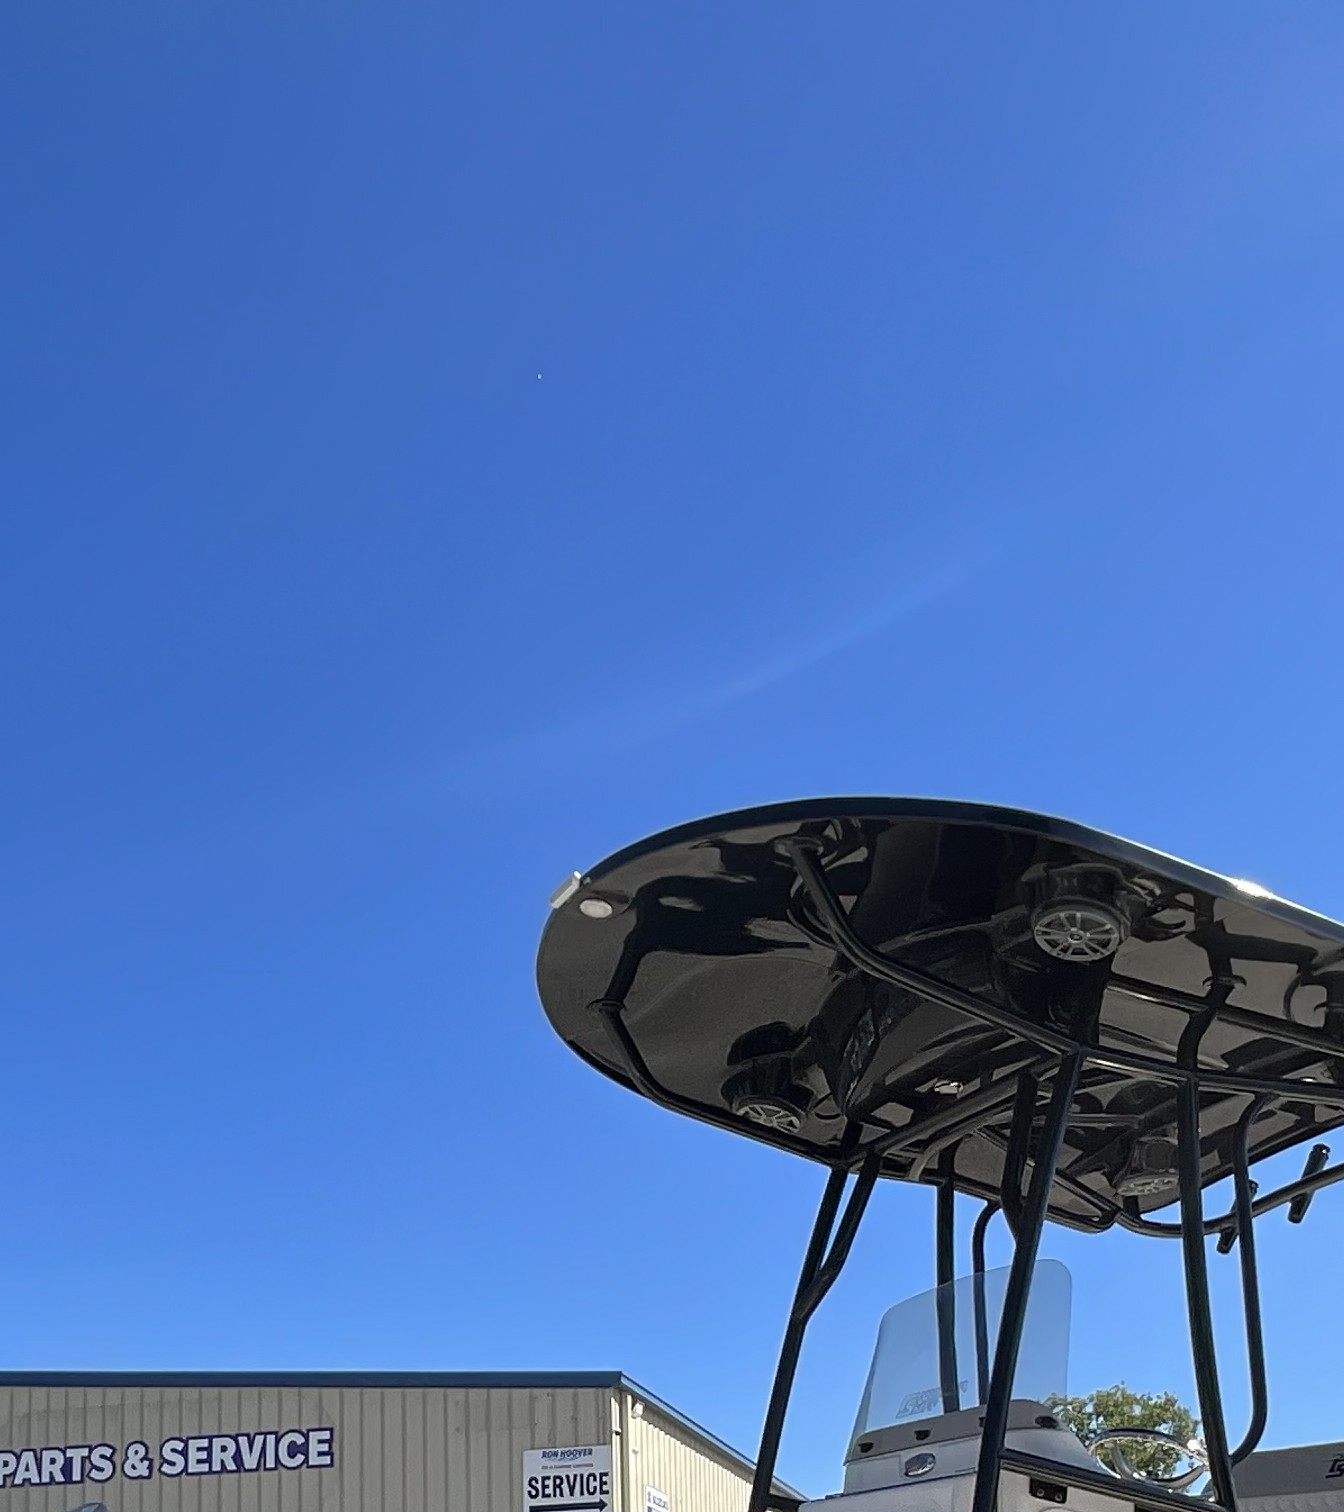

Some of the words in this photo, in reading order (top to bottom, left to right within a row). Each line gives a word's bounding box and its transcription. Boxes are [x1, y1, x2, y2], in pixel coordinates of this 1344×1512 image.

[122, 1439, 153, 1480] &
[160, 1427, 334, 1477] SERVICE
[527, 1471, 610, 1499] SERVICE
